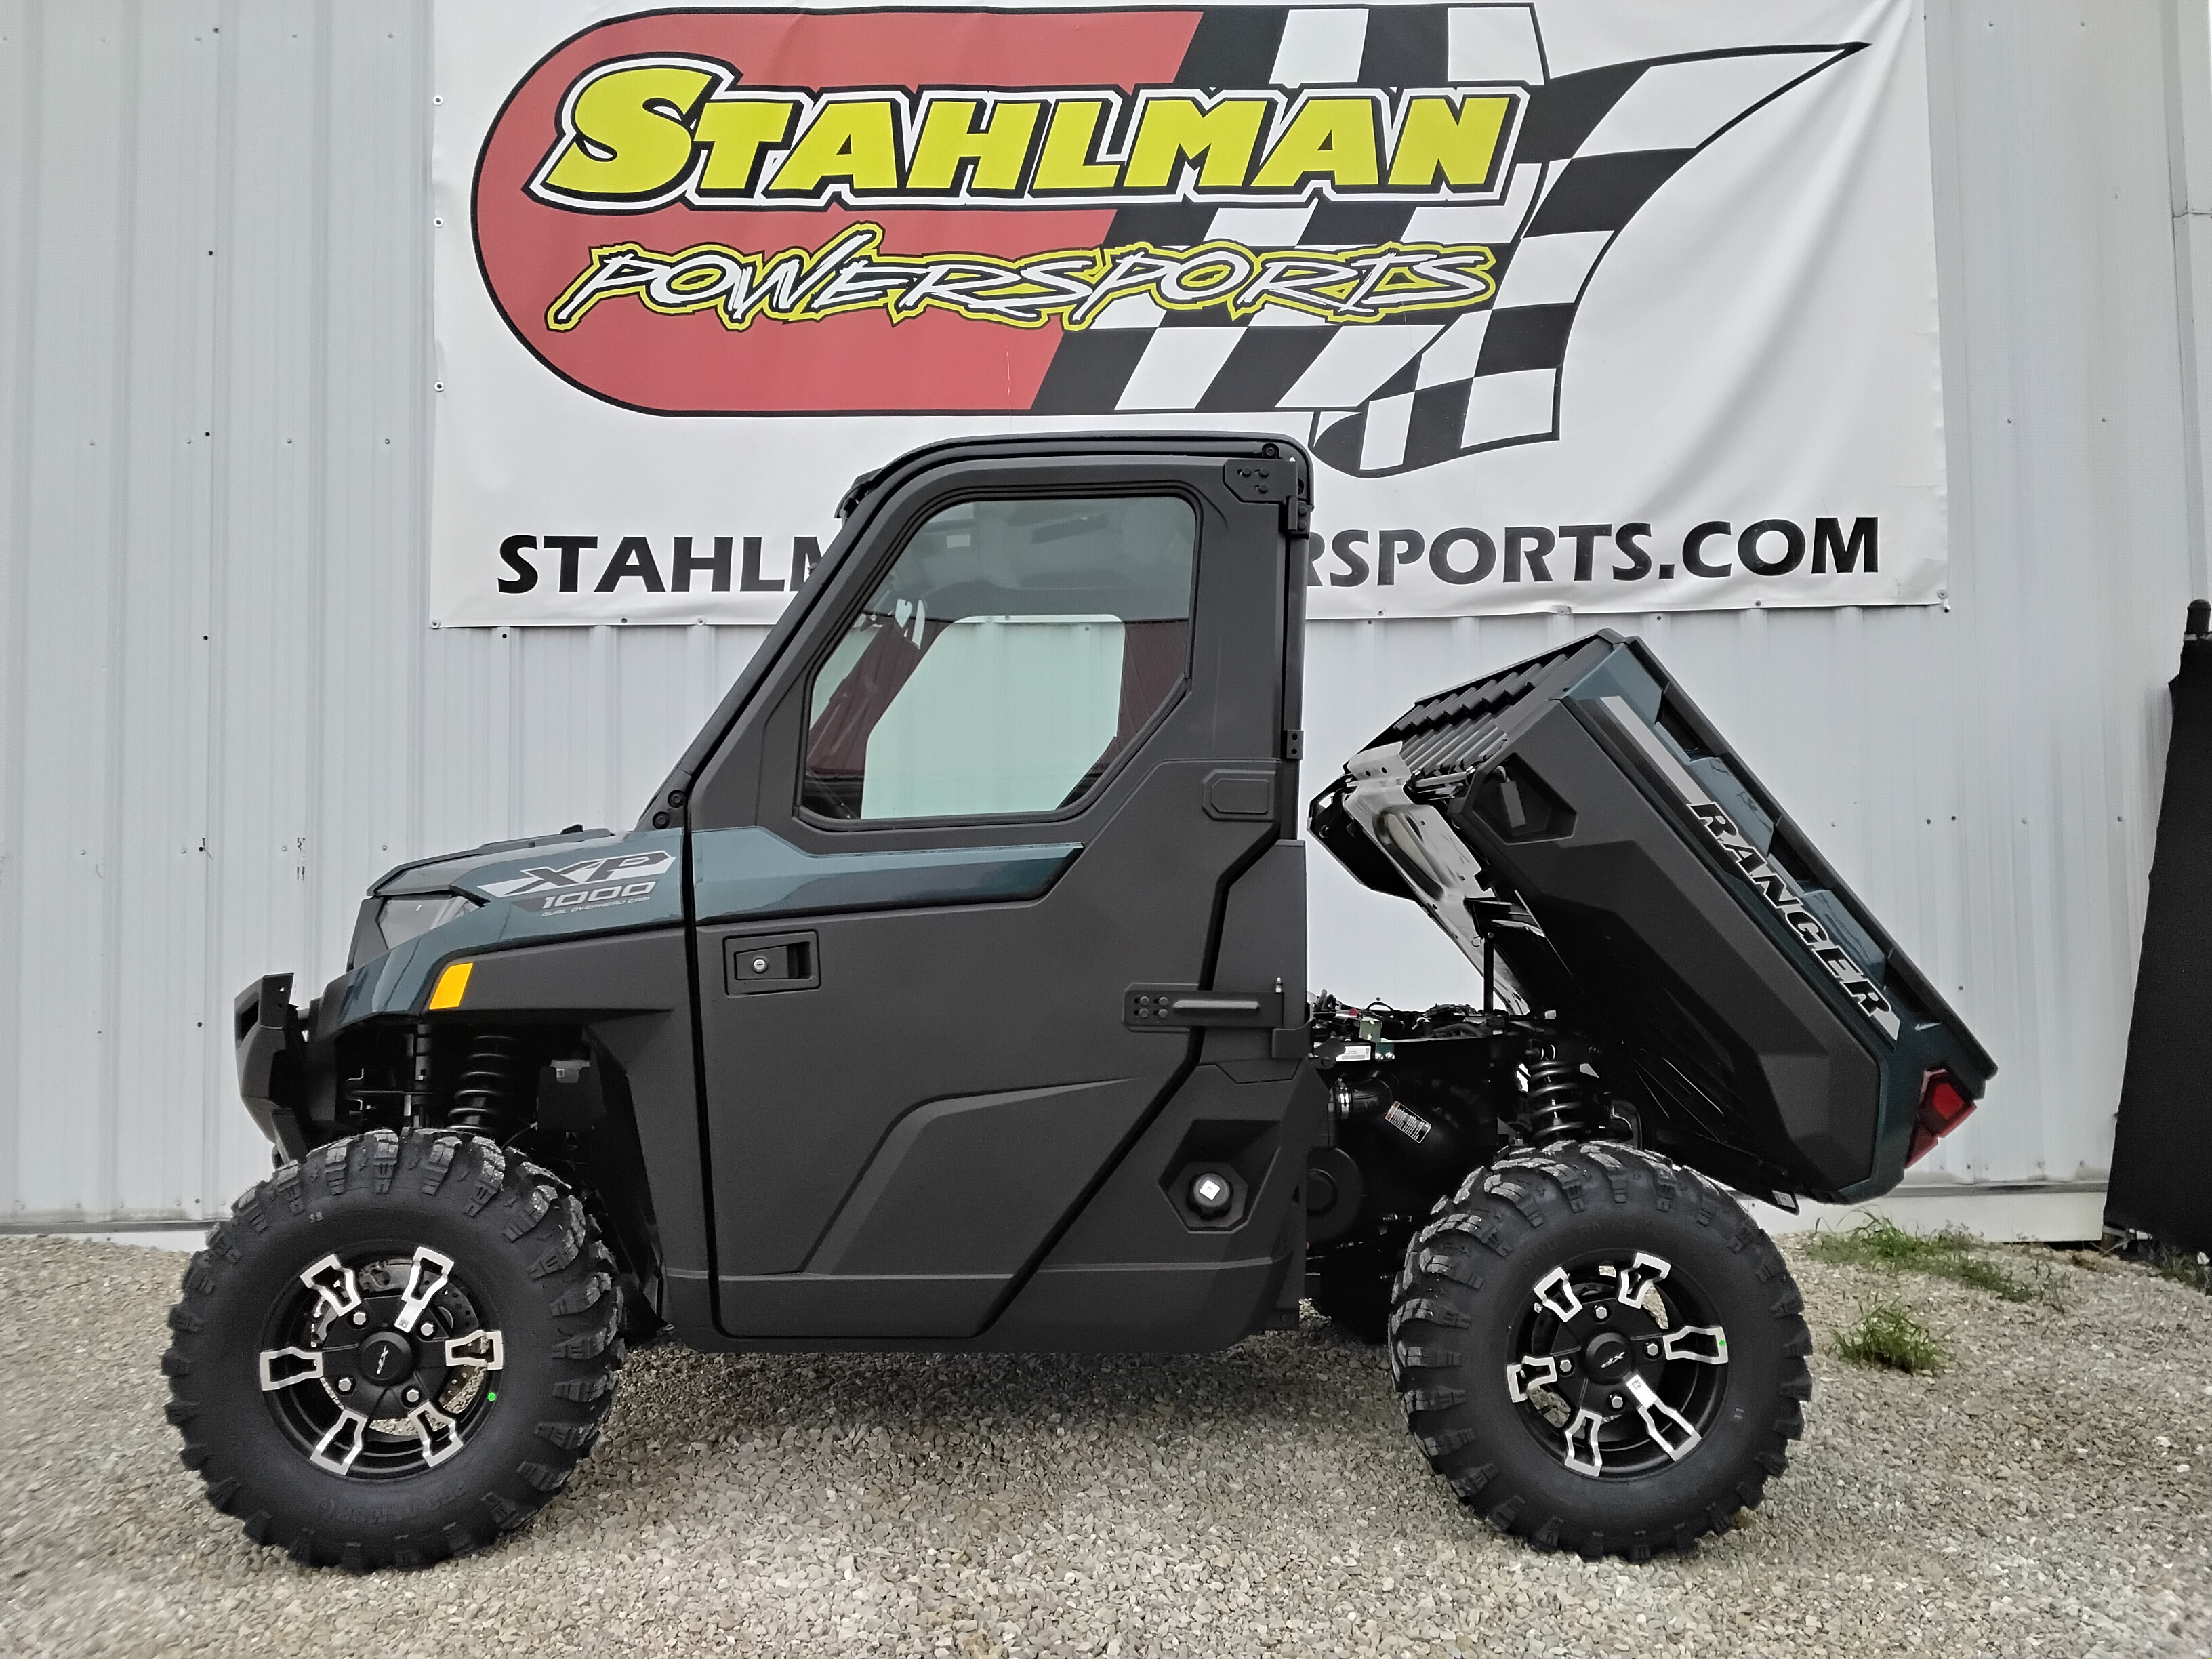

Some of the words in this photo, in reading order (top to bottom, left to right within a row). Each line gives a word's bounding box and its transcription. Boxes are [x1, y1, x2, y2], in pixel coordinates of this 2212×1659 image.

[530, 58, 1522, 207] STAHLMAN
[550, 227, 1495, 325] POWERSPORTS
[501, 851, 671, 896] XP
[541, 909, 569, 917] DUAL
[571, 900, 626, 912] OVERHEAD
[627, 896, 651, 904] CAM
[543, 881, 656, 909] 1000
[1687, 802, 1892, 1017] RANGER
